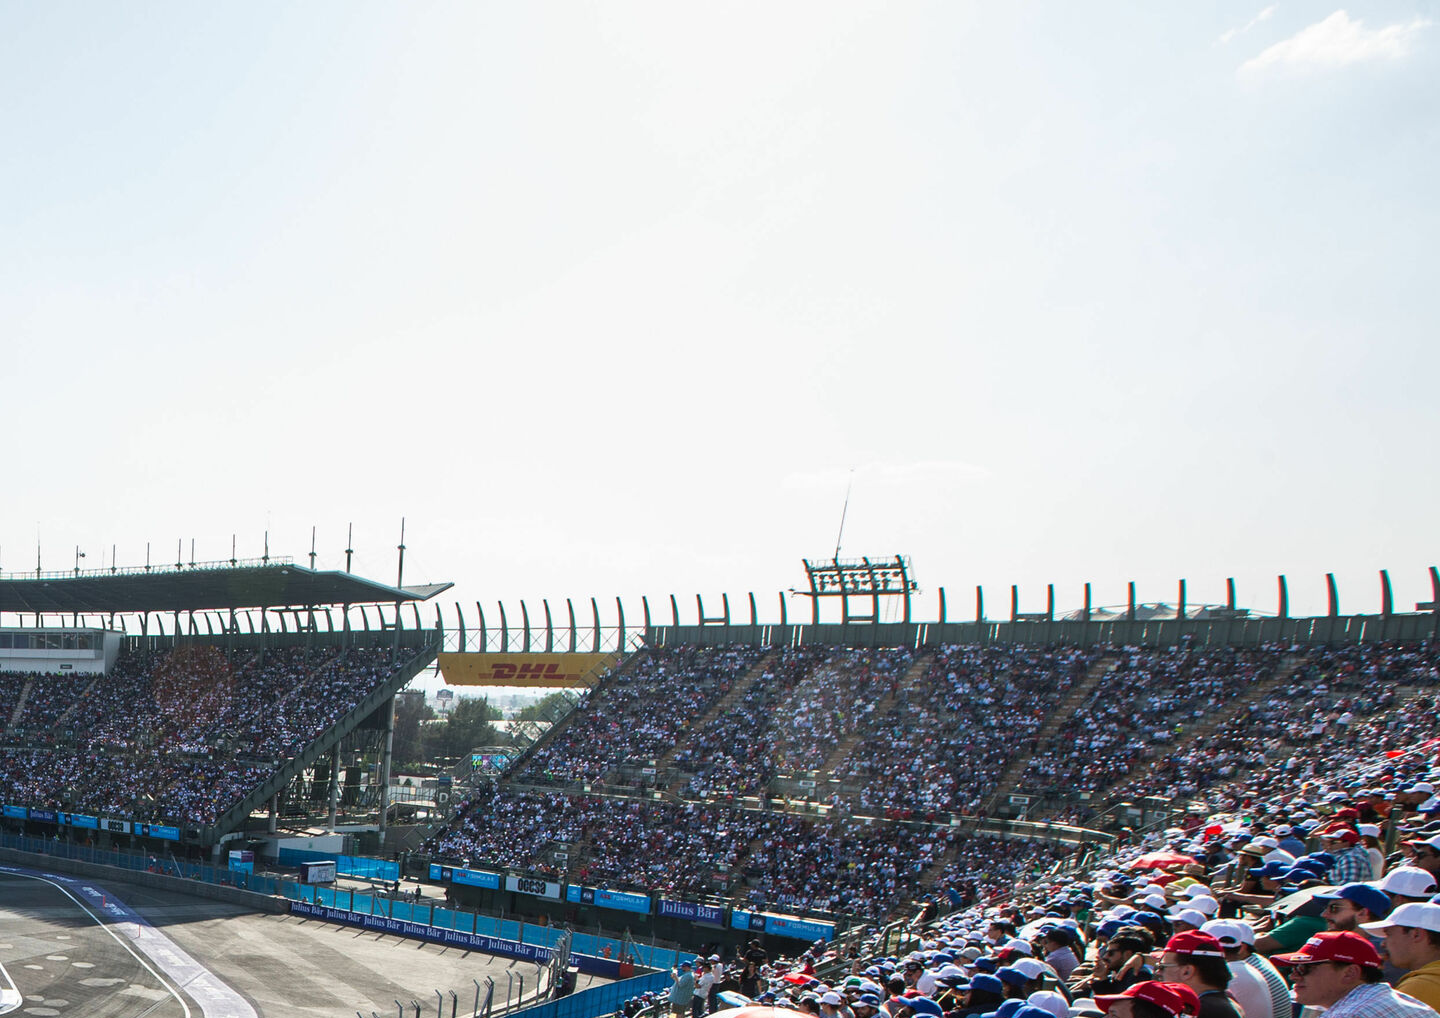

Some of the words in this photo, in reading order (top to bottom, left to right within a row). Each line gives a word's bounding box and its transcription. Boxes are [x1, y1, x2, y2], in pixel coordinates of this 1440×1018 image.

[491, 664, 566, 679] DHL
[517, 878, 546, 894] ocesa
[661, 901, 695, 916] Julius
[696, 907, 718, 919] Bär
[363, 914, 385, 928] Julius
[387, 919, 400, 931] Bär
[403, 922, 425, 935] Julius
[426, 926, 441, 938] Bär
[444, 930, 468, 944] Julius
[469, 935, 485, 947] Bär
[488, 938, 513, 952] Julius
[514, 943, 531, 955] Bär
